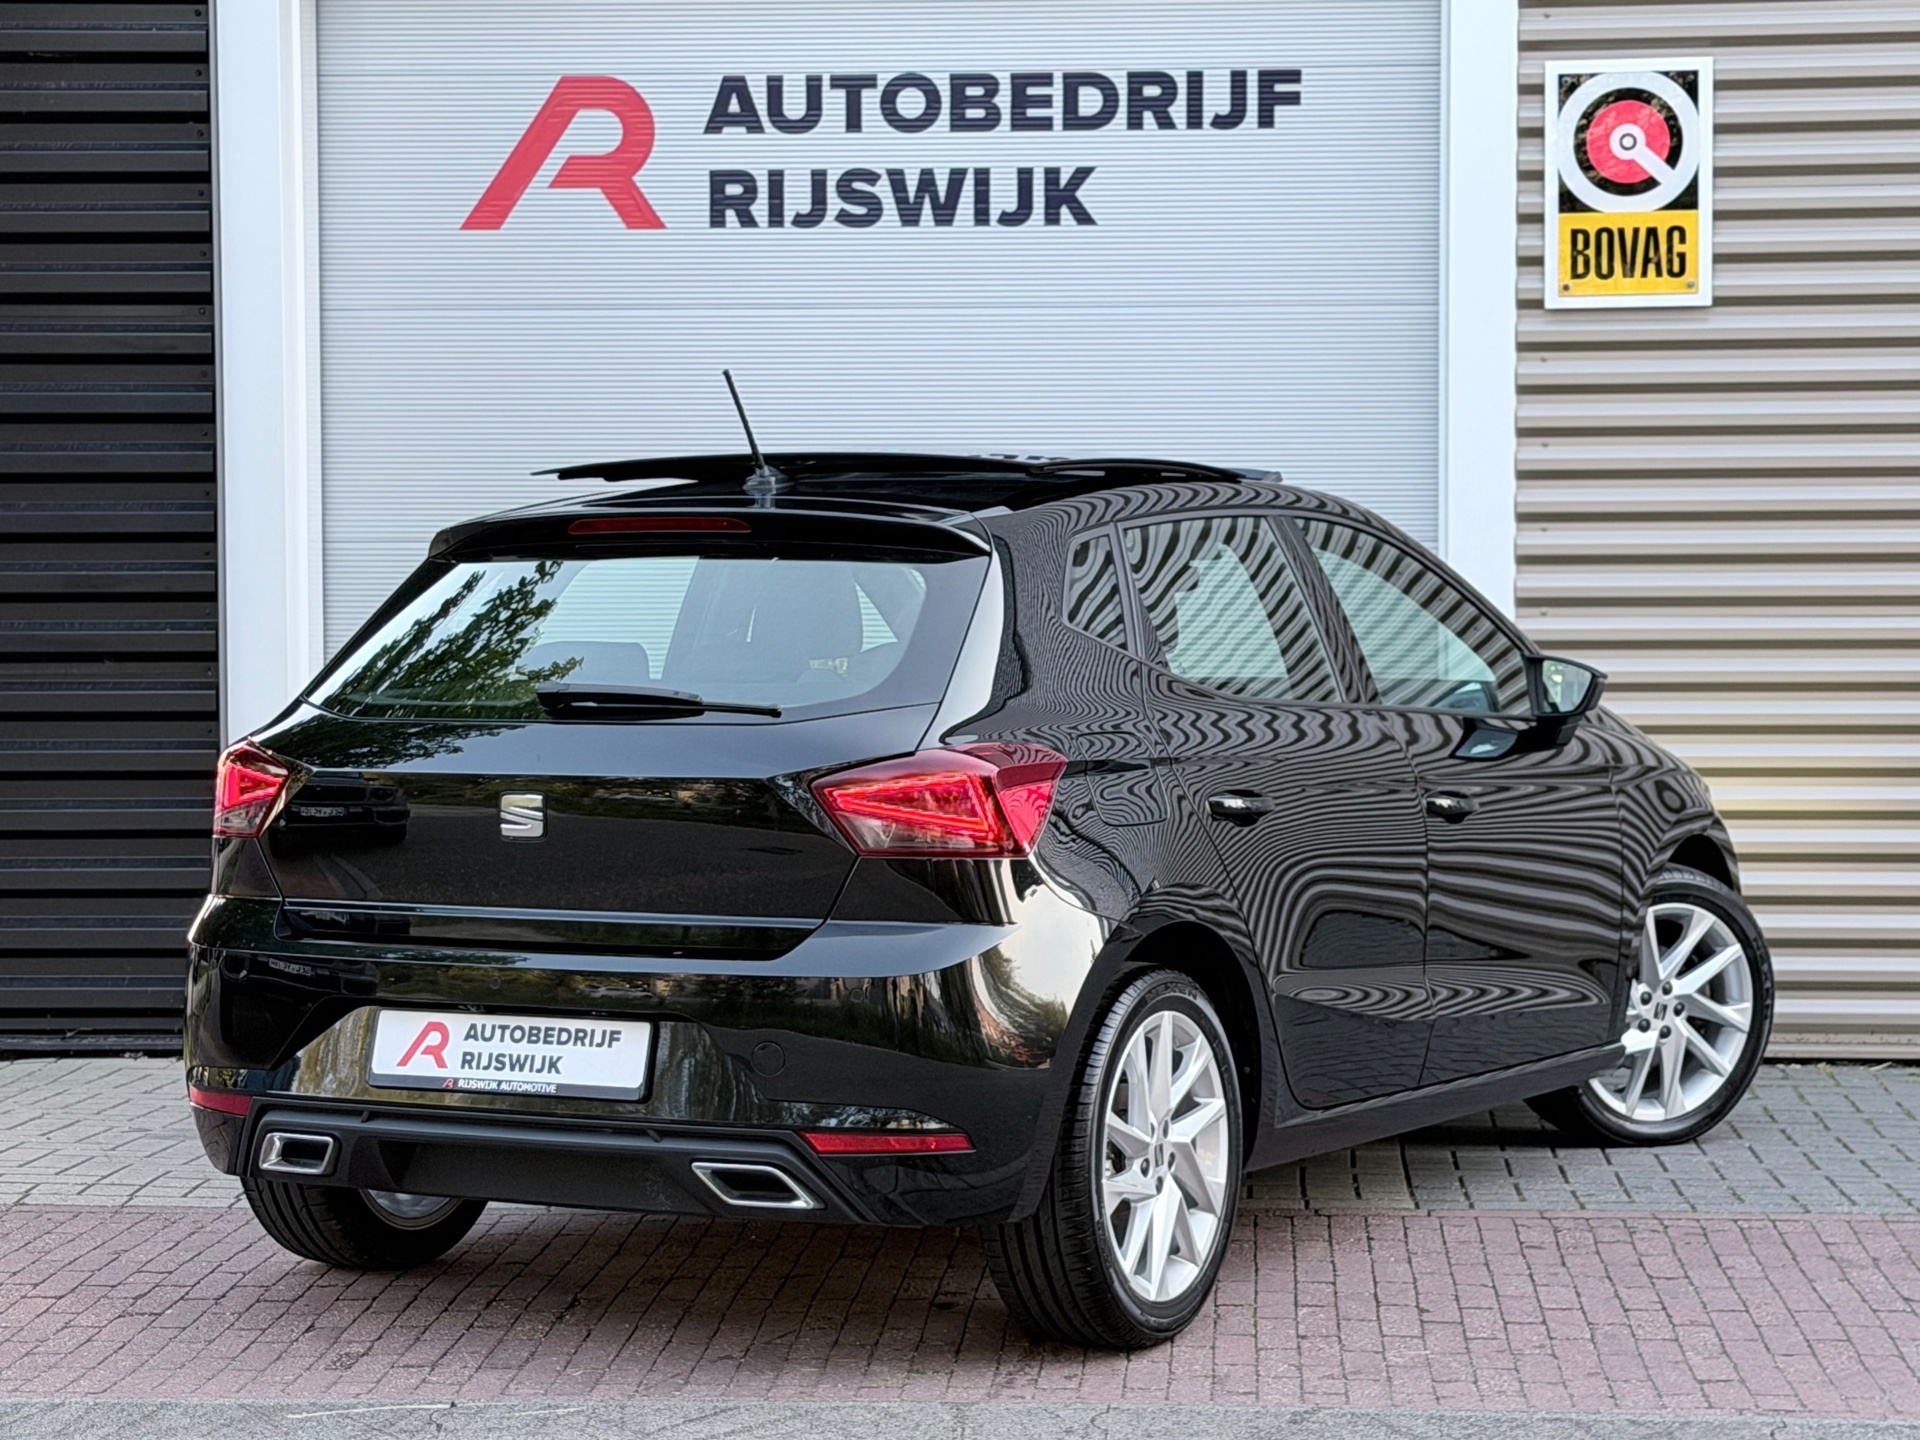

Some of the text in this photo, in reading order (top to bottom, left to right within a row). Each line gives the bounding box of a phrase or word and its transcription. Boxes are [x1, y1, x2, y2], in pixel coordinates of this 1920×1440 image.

[703, 69, 1302, 134] AUTOBEDRIJF
[709, 166, 1097, 229] RIJSWIJK
[1570, 225, 1687, 280] BOVAG
[463, 1022, 623, 1049] AUTOBEDRIJF
[460, 1051, 564, 1075] RIJSWIJK
[458, 1078, 499, 1090] RIJSWIJK
[500, 1081, 557, 1093] AUTOMOTIVE
